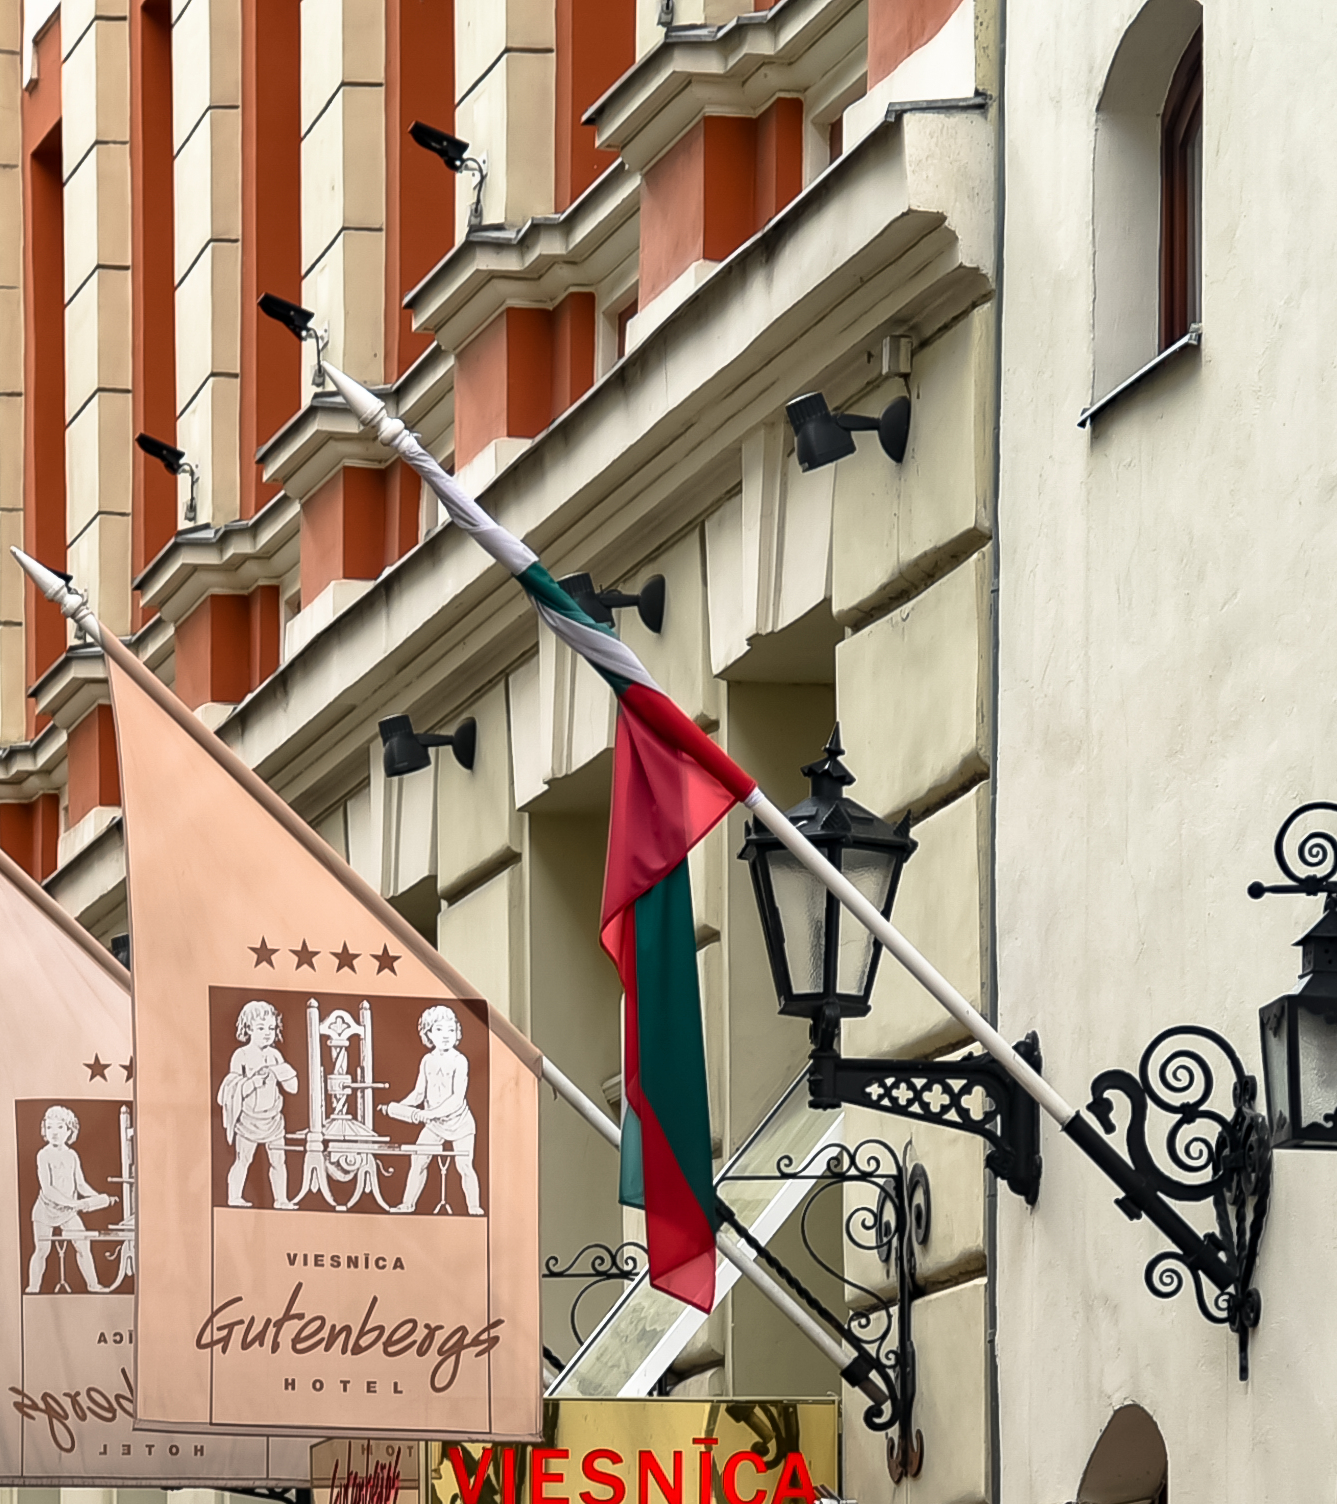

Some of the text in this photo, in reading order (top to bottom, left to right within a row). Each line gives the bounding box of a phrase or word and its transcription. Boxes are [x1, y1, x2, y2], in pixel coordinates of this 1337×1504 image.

[285, 1252, 406, 1271] VIESNĪCA
[195, 1281, 506, 1394] Gutenbergs
[283, 1377, 405, 1395] HOTEL
